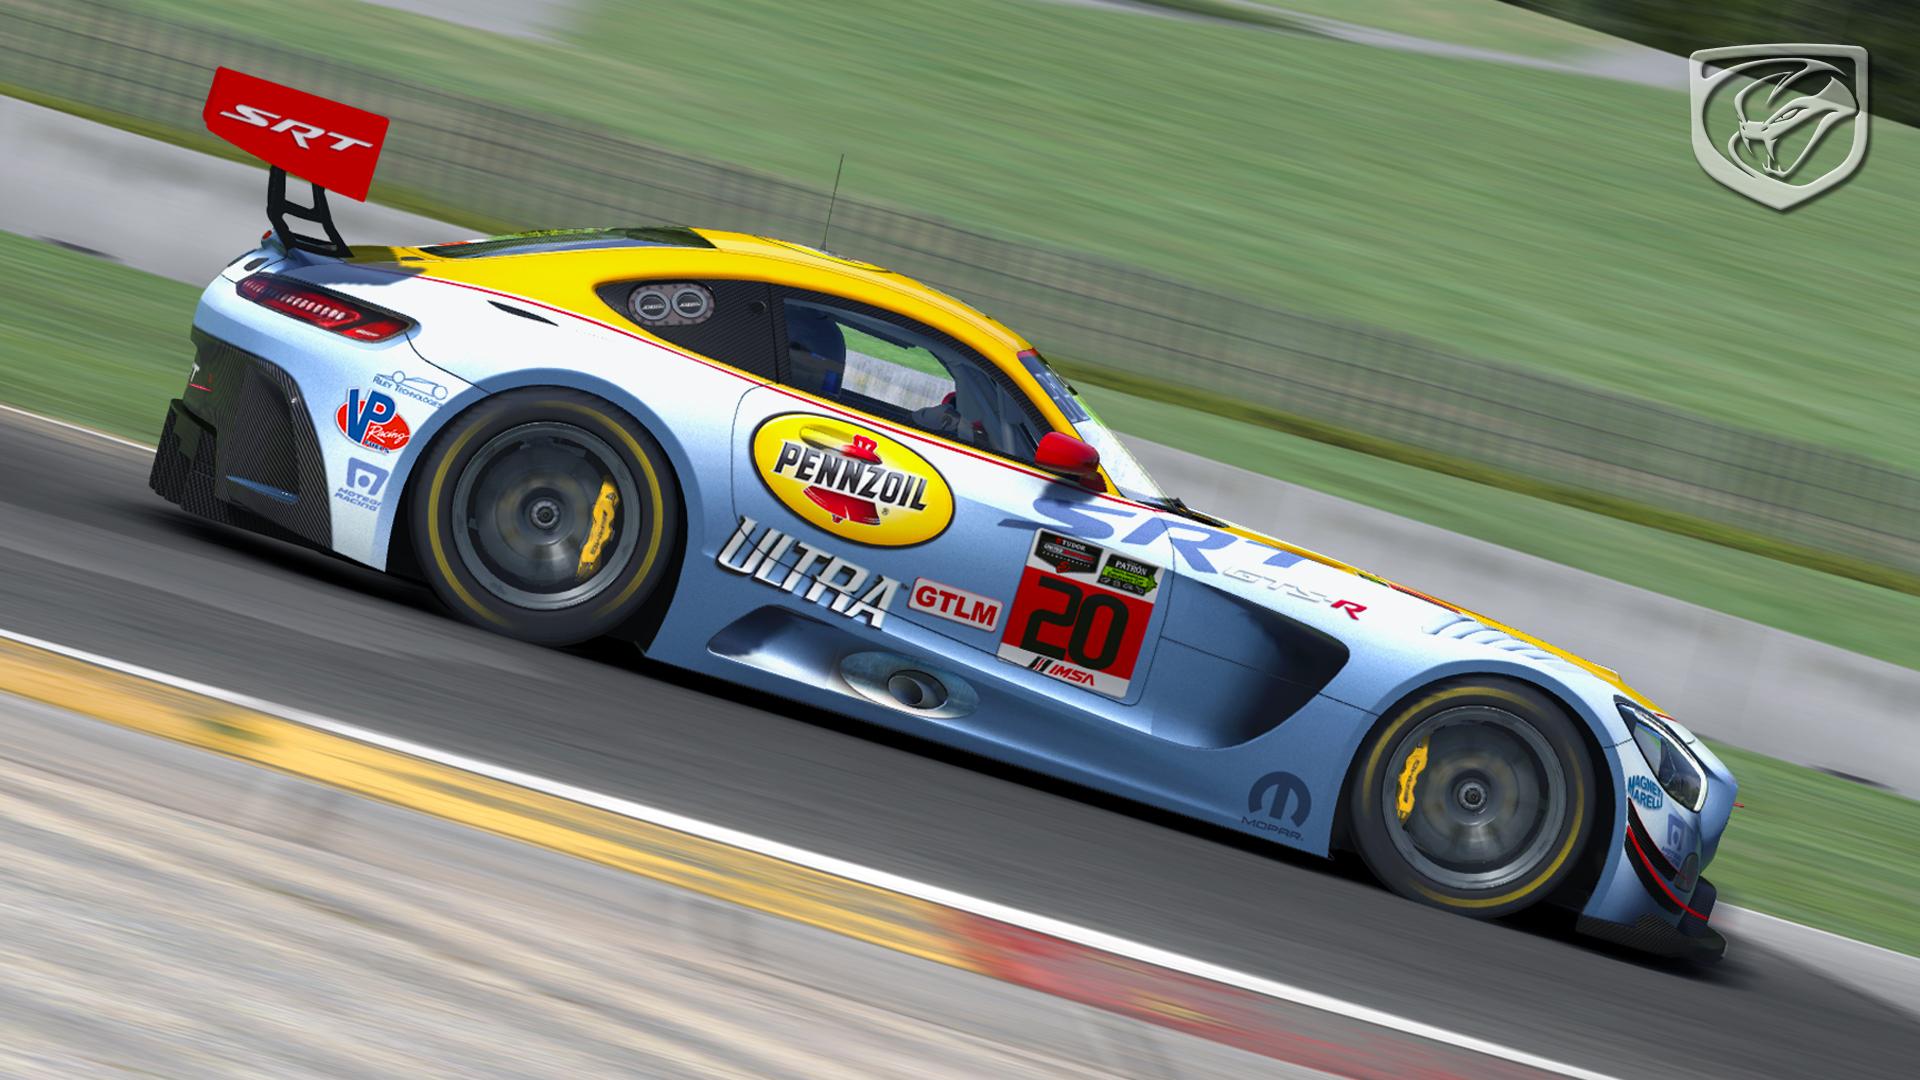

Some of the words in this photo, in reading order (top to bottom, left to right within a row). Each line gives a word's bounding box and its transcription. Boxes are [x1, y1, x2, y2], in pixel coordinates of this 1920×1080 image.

[219, 104, 374, 151] SRT
[347, 388, 396, 444] VP
[366, 425, 411, 444] Racing
[773, 441, 928, 511] PENNZOIL
[1062, 540, 1086, 552] TUDOR
[715, 515, 901, 630] ULTRA
[914, 585, 998, 626] GTLM
[1020, 576, 1129, 670] 20
[1048, 664, 1095, 687] IMSA
